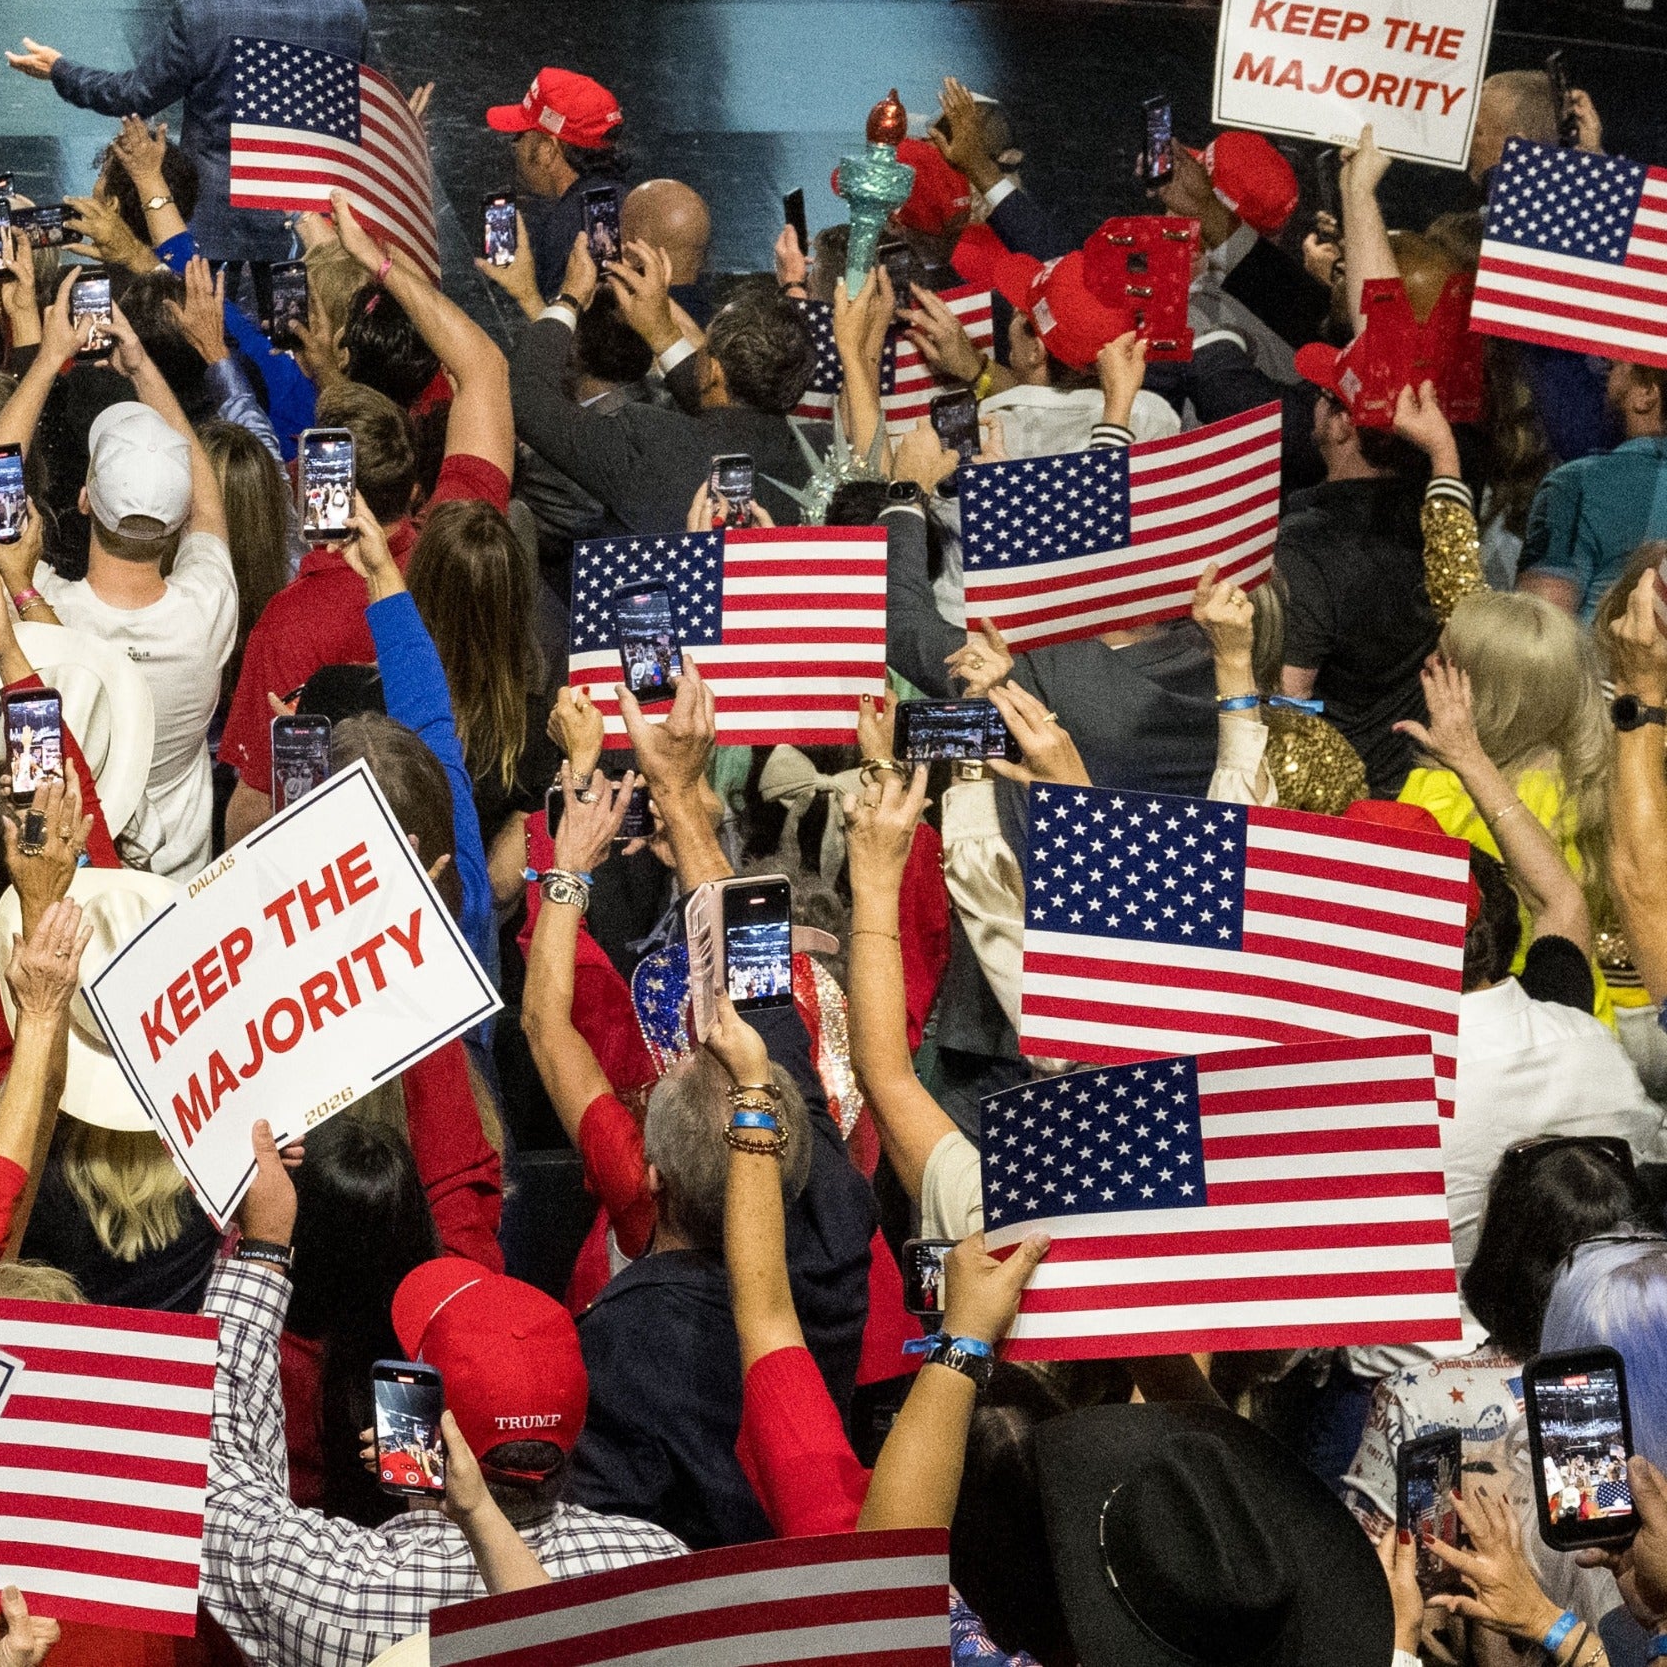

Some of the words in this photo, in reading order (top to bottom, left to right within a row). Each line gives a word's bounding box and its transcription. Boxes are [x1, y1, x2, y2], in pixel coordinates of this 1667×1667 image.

[1252, 0, 1370, 41] KEEP
[1386, 18, 1463, 60] THE
[1235, 54, 1464, 114] MAJORITY
[1328, 133, 1358, 146] 202
[187, 854, 236, 899] DALLAS
[141, 928, 253, 1061] KEEP
[264, 842, 379, 946] THE
[172, 910, 423, 1145] MAJORITY
[304, 1086, 354, 1126] 2026
[494, 1414, 562, 1431] TRUMP
